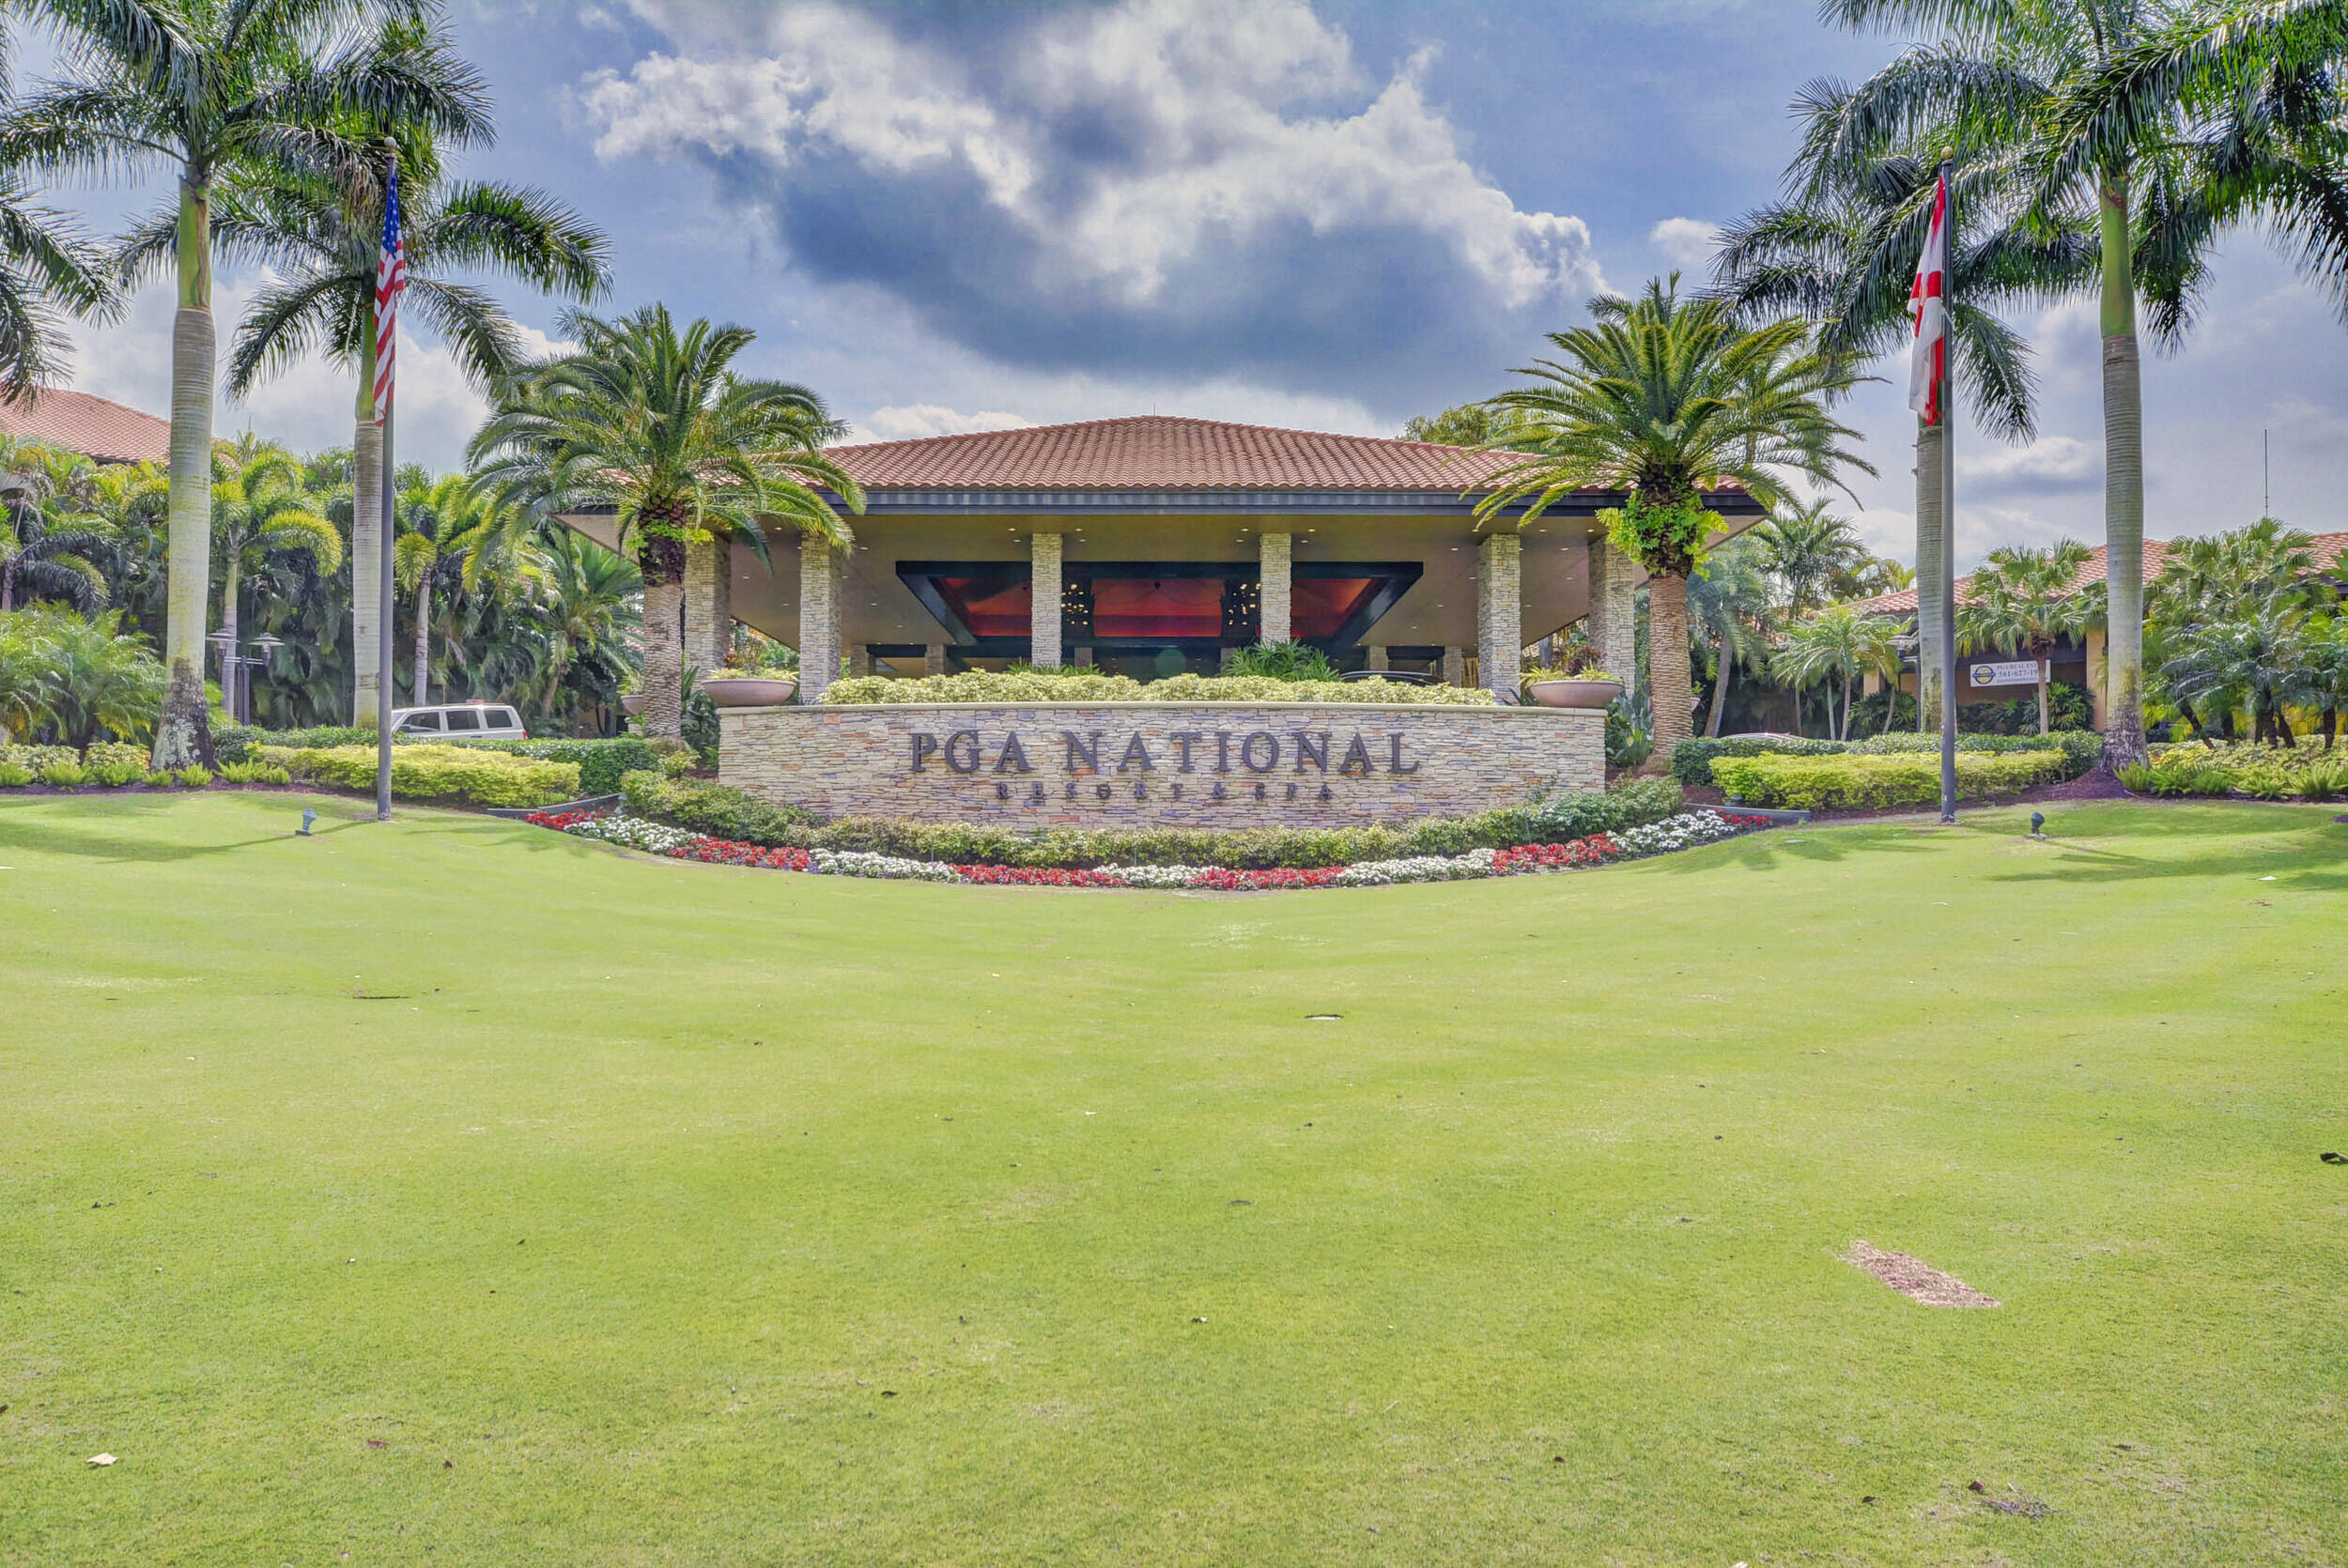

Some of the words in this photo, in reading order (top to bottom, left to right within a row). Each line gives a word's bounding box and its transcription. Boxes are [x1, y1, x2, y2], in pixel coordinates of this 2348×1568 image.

[909, 730, 1032, 773] PGA
[1061, 730, 1420, 773] NATIONAL
[996, 781, 1183, 799] RESORT
[1211, 781, 1228, 799] &
[1254, 781, 1334, 800] SPA
